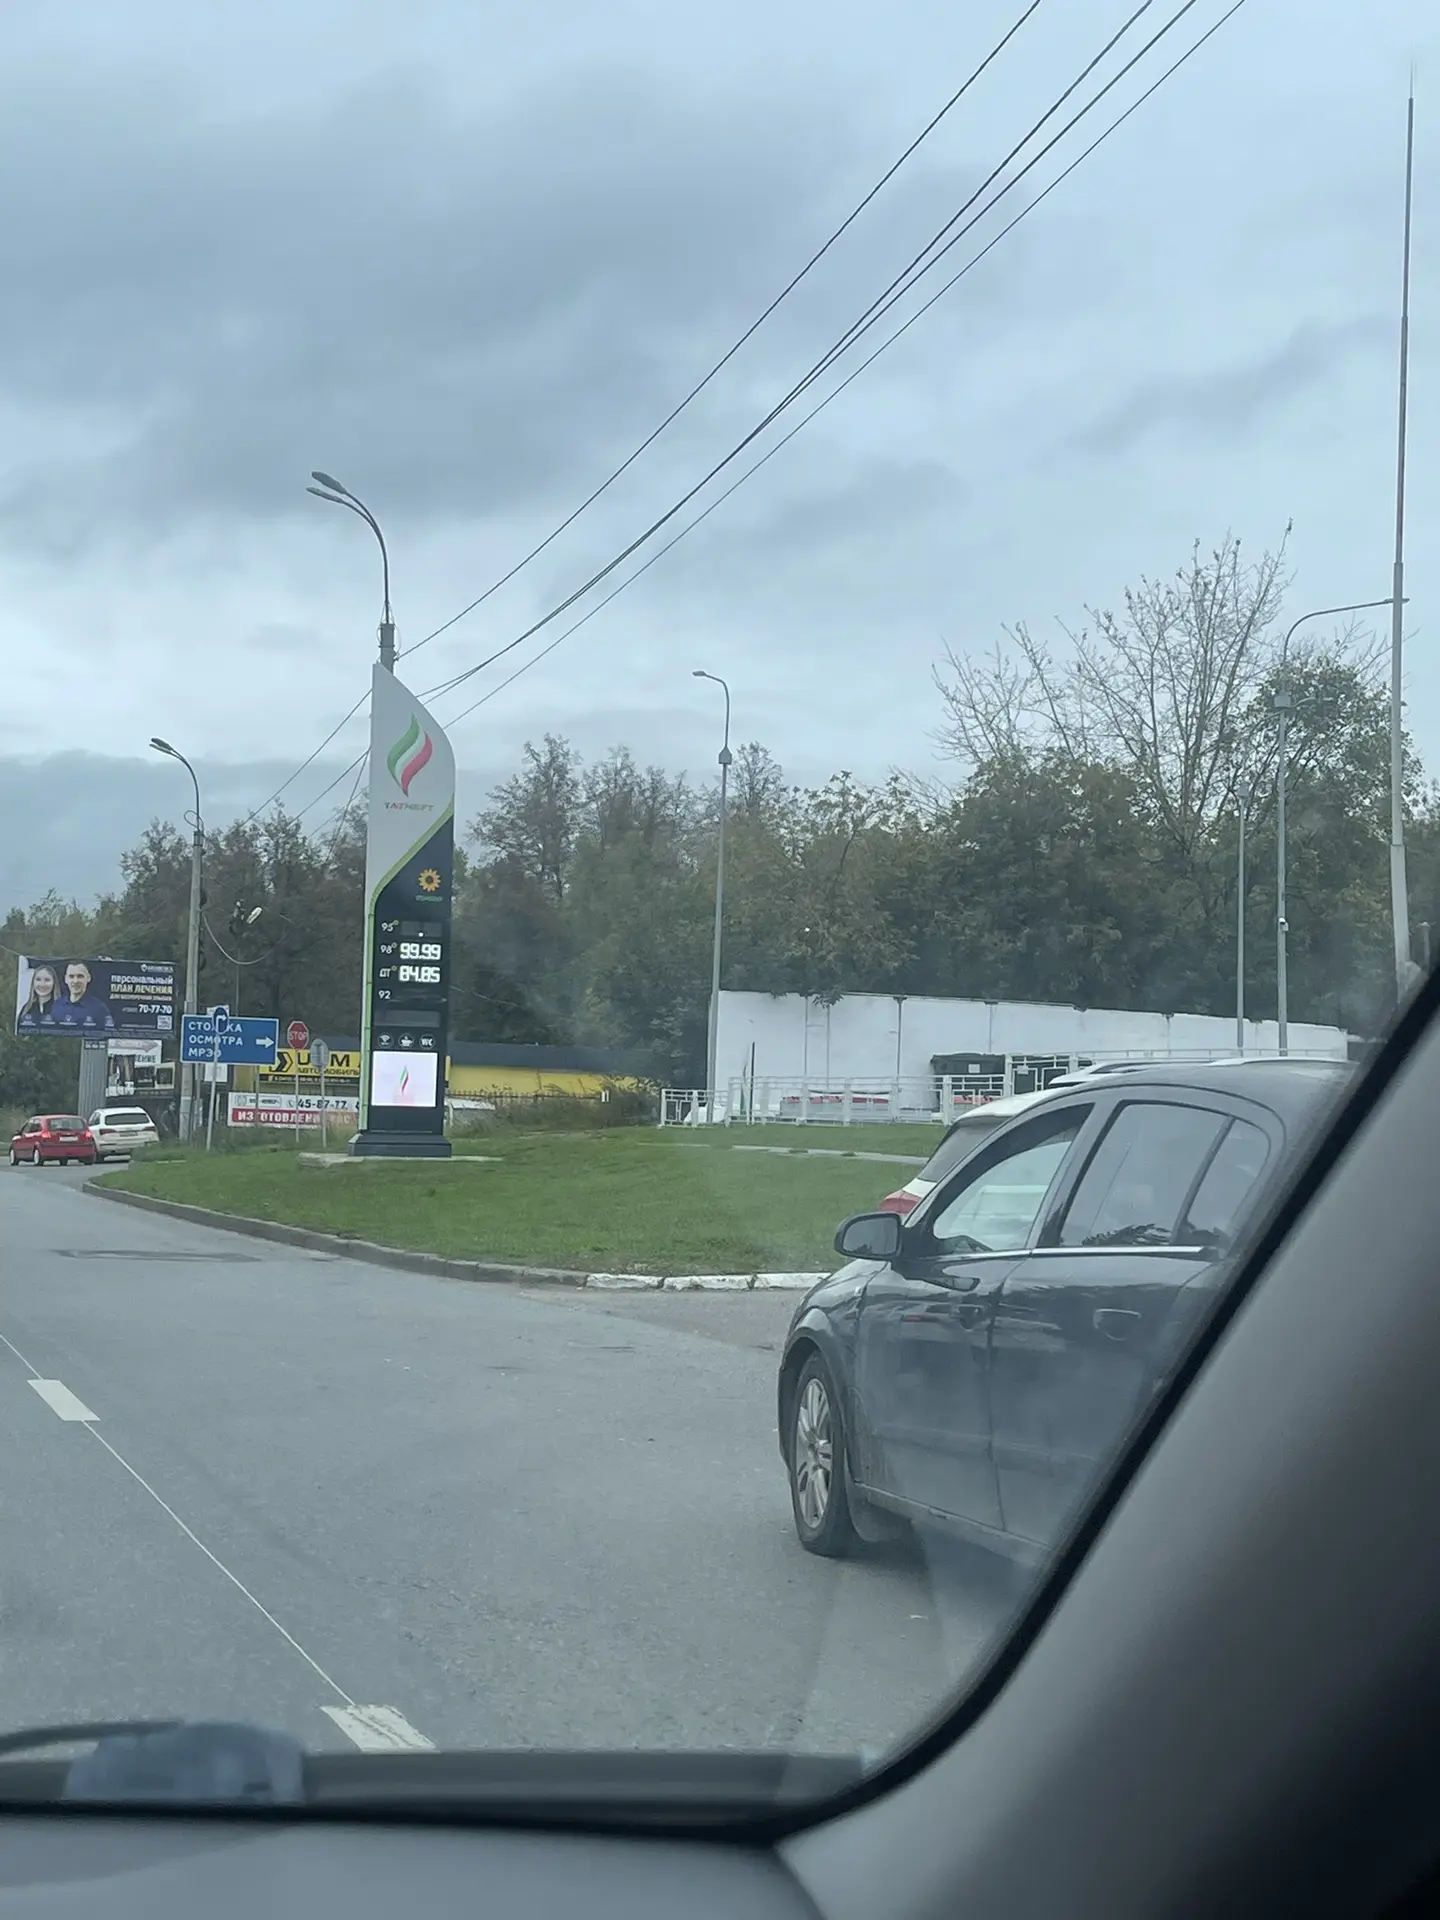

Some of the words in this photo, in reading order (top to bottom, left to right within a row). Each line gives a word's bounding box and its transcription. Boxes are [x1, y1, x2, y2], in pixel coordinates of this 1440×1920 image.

[381, 922, 394, 932] 95
[380, 944, 392, 954] 98
[400, 943, 441, 960] 99.99
[399, 965, 441, 983] 84.85
[110, 983, 134, 993] ПЛАН
[134, 984, 173, 995] ЛЕЧЕНИЯ
[378, 990, 391, 1000] 92
[138, 1003, 172, 1015] 70-77-70
[188, 1021, 243, 1033] СТОКА
[188, 1034, 244, 1046] ОСМОТРА
[288, 1030, 308, 1041] STOP
[421, 1038, 433, 1046] WC
[188, 1047, 222, 1058] МРЭО
